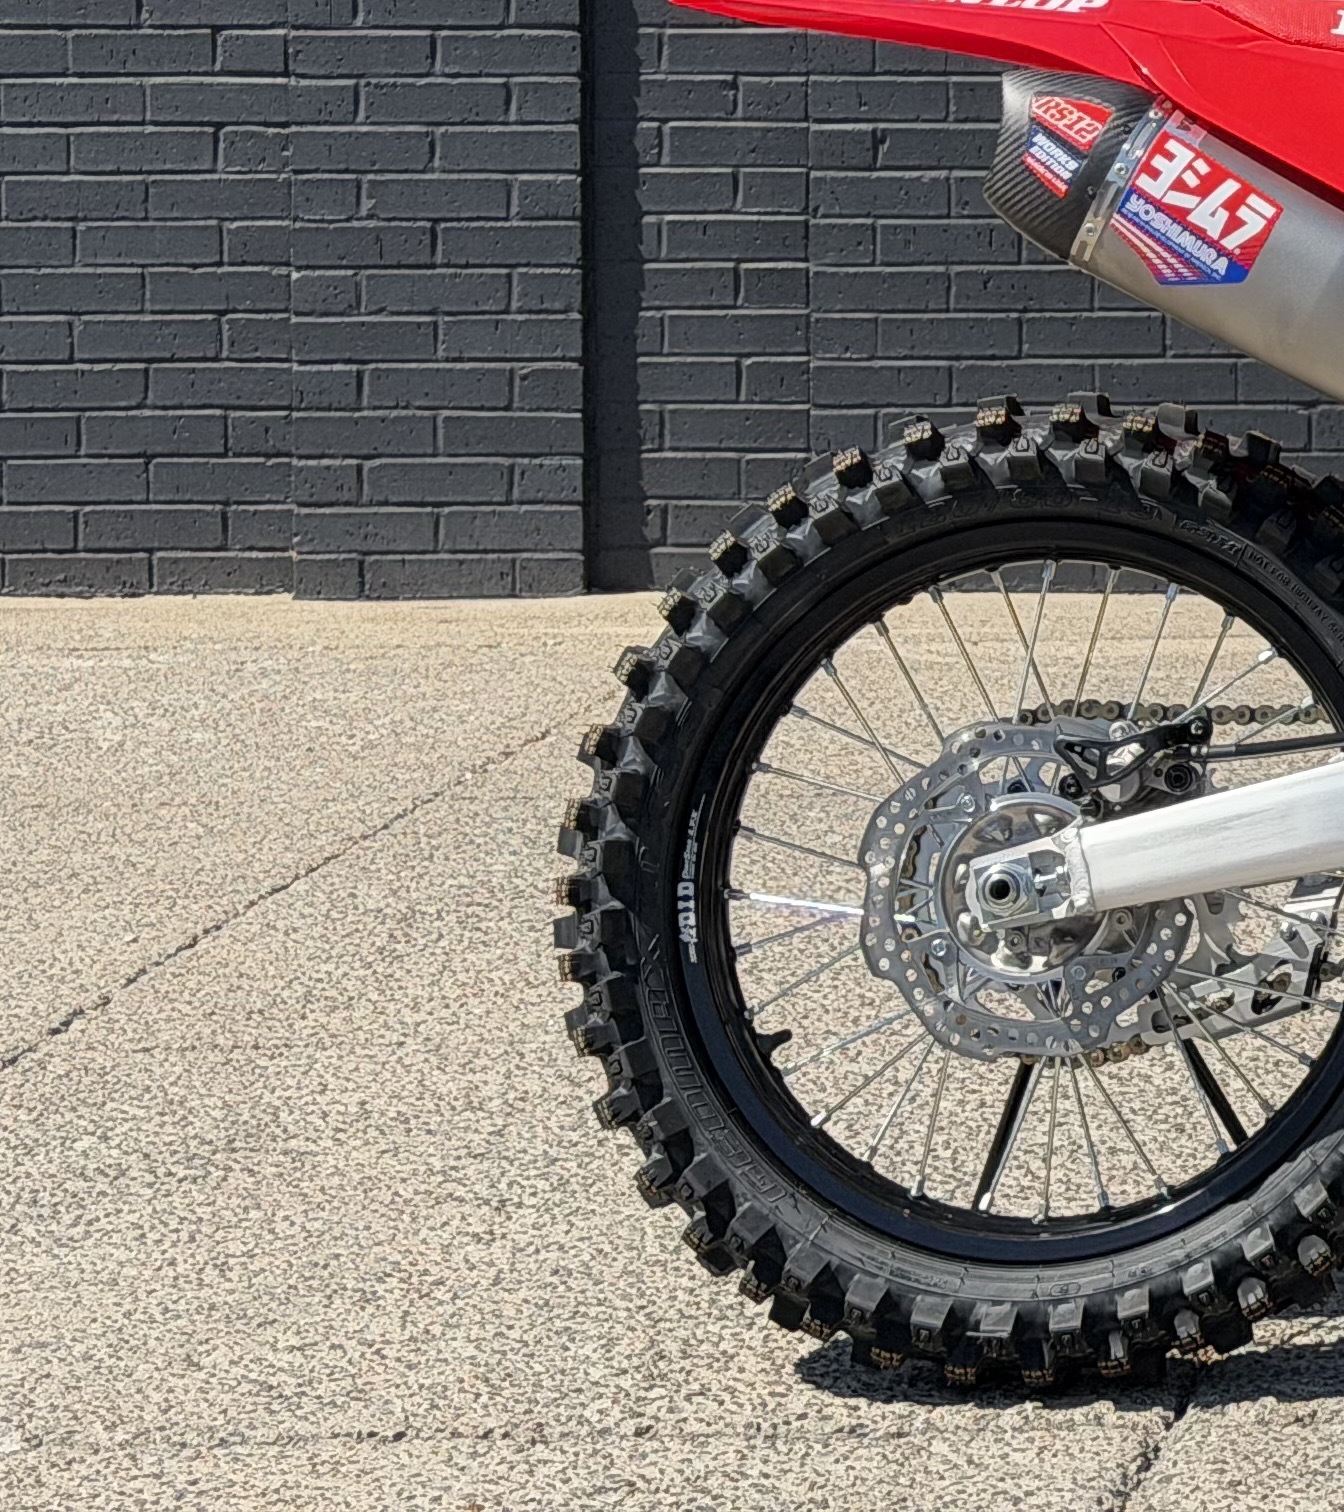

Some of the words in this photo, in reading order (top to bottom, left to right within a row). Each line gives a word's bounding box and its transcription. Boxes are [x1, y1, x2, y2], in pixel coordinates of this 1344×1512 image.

[1027, 144, 1074, 182] EDITION
[1031, 132, 1081, 172] WORKS
[1134, 137, 1278, 252] ヨシムラ
[1123, 192, 1230, 276] YOSHIMURA
